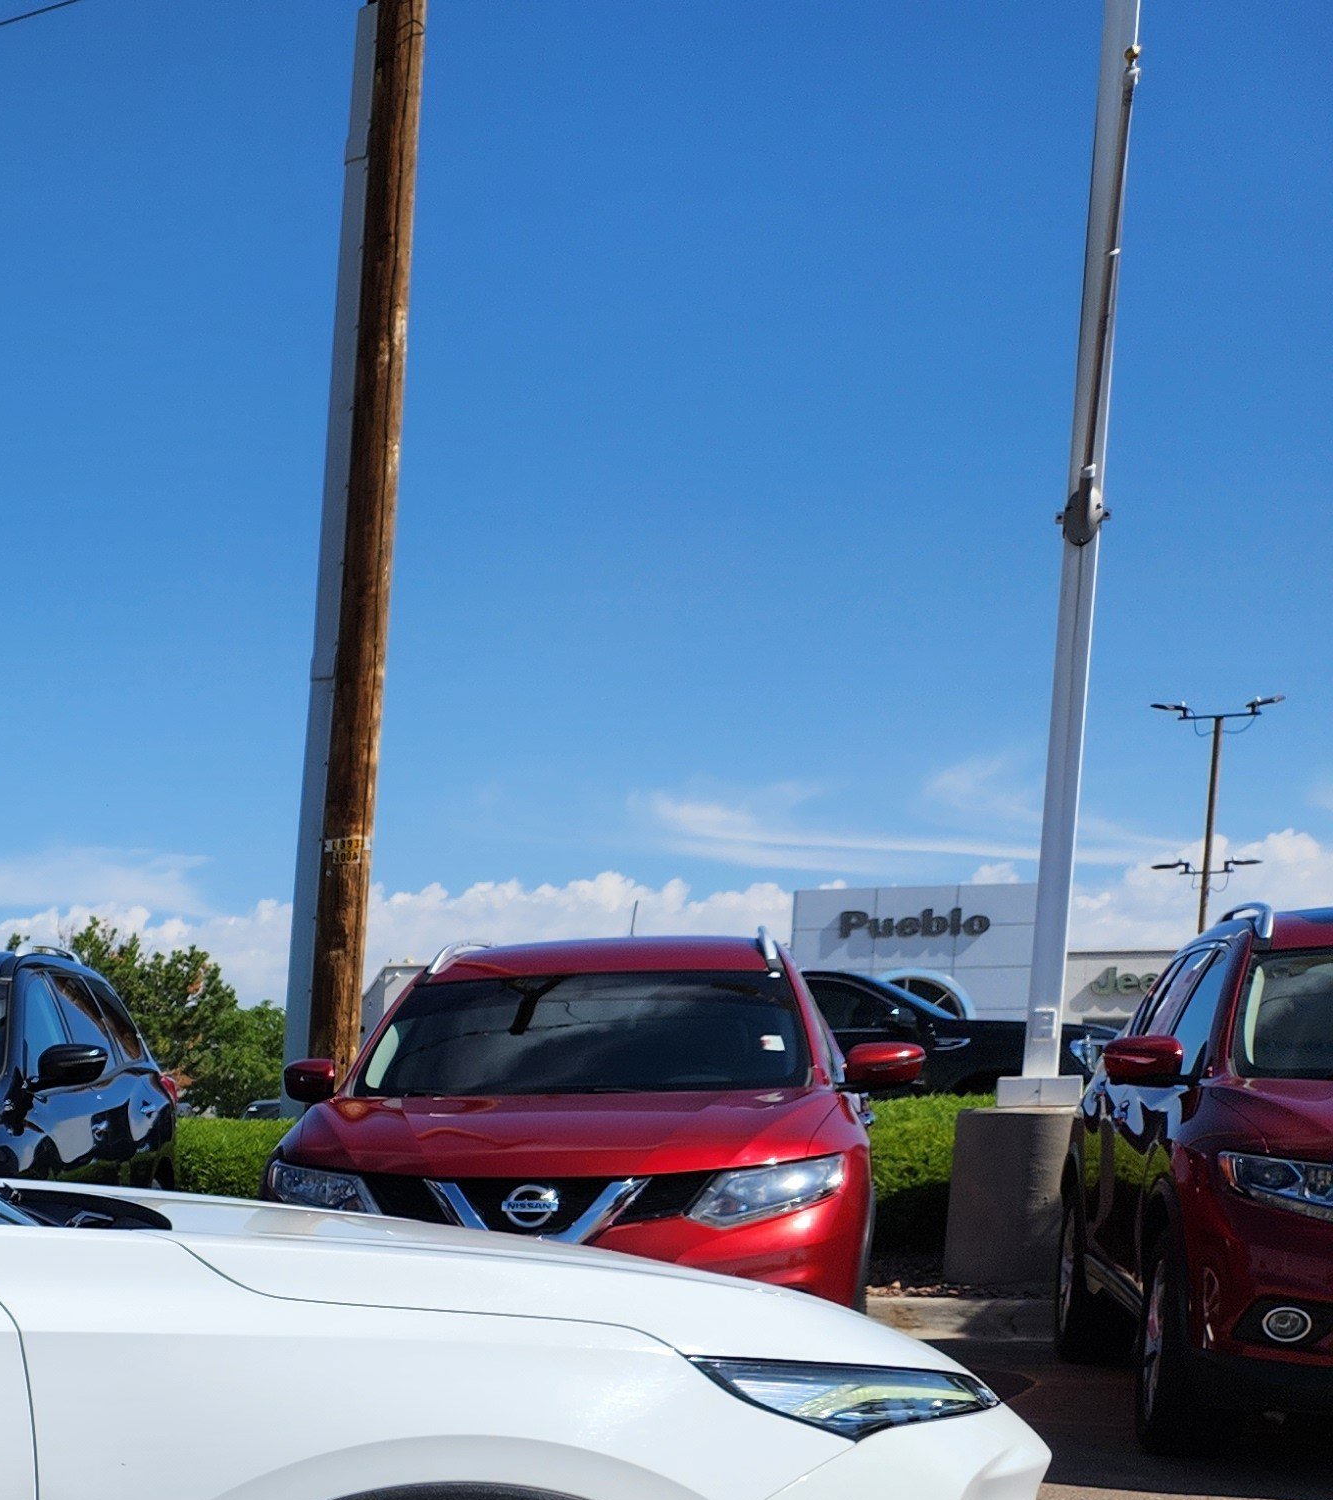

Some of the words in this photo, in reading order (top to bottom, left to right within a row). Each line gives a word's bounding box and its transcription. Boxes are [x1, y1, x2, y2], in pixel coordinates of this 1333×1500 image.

[839, 907, 990, 939] Pueblo
[1091, 966, 1159, 996] Jee
[507, 1202, 551, 1210] NISSAN
